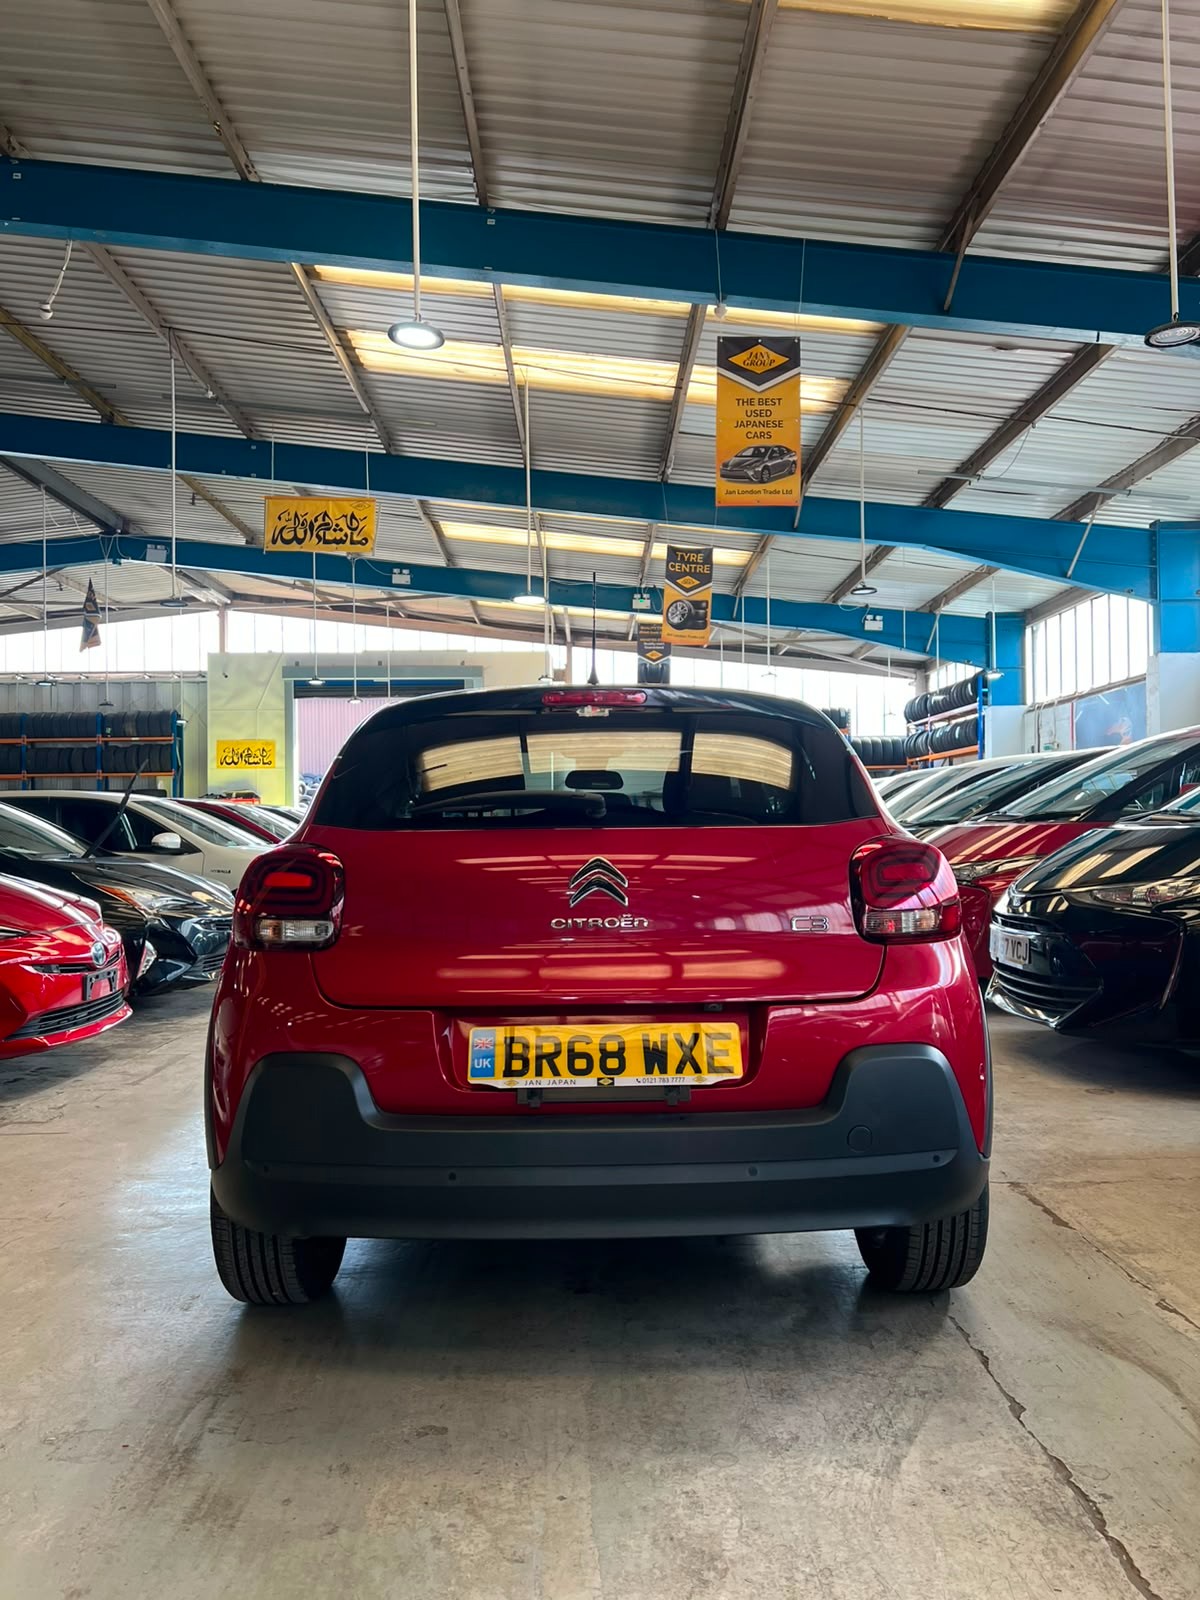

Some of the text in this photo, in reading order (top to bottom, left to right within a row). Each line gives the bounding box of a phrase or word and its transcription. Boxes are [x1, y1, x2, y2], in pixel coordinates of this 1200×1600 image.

[742, 359, 776, 367] GROUP
[736, 398, 782, 406] THE BEST
[745, 409, 772, 418] USED
[734, 420, 783, 429] JAPANESE
[745, 431, 772, 440] CARS
[676, 552, 704, 562] TYRE
[668, 562, 710, 573] CENTRE
[791, 914, 829, 932] C3
[502, 1031, 735, 1078] BR68 WXE
[474, 1058, 491, 1069] UK
[524, 1078, 577, 1087] JAN JAPAN
